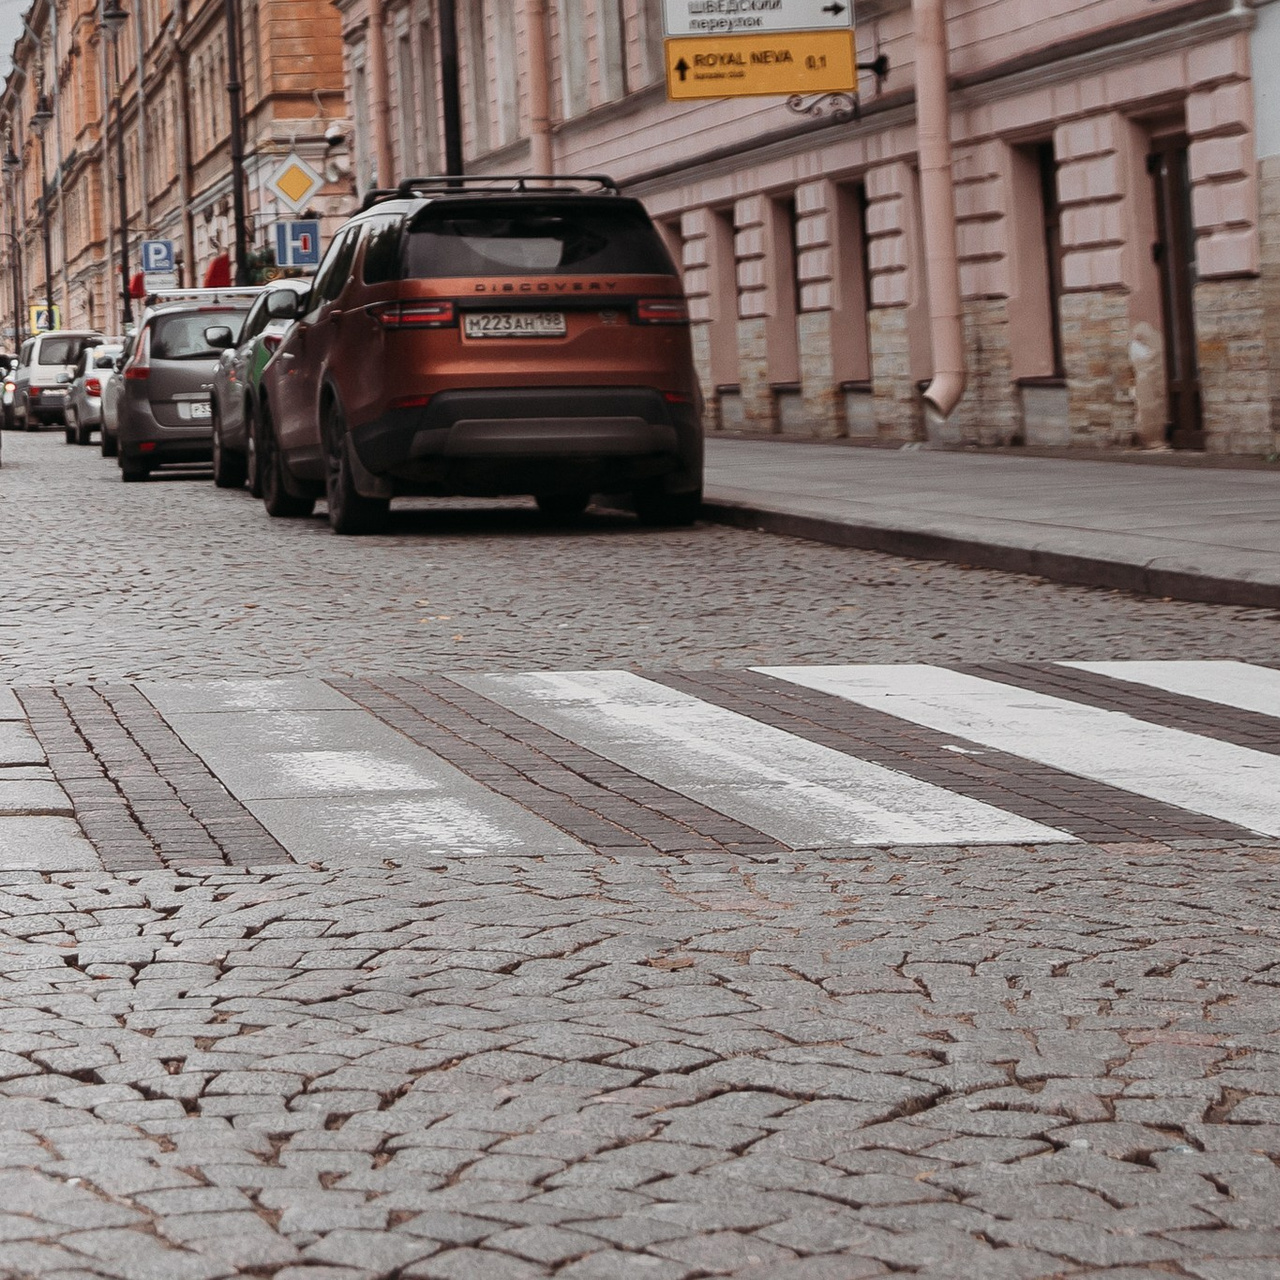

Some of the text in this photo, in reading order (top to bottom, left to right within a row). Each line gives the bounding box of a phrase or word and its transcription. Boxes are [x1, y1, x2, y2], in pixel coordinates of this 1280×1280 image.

[693, 49, 794, 67] ROYAL NEVA
[149, 243, 168, 268] P
[474, 282, 617, 292] DISCOVERY
